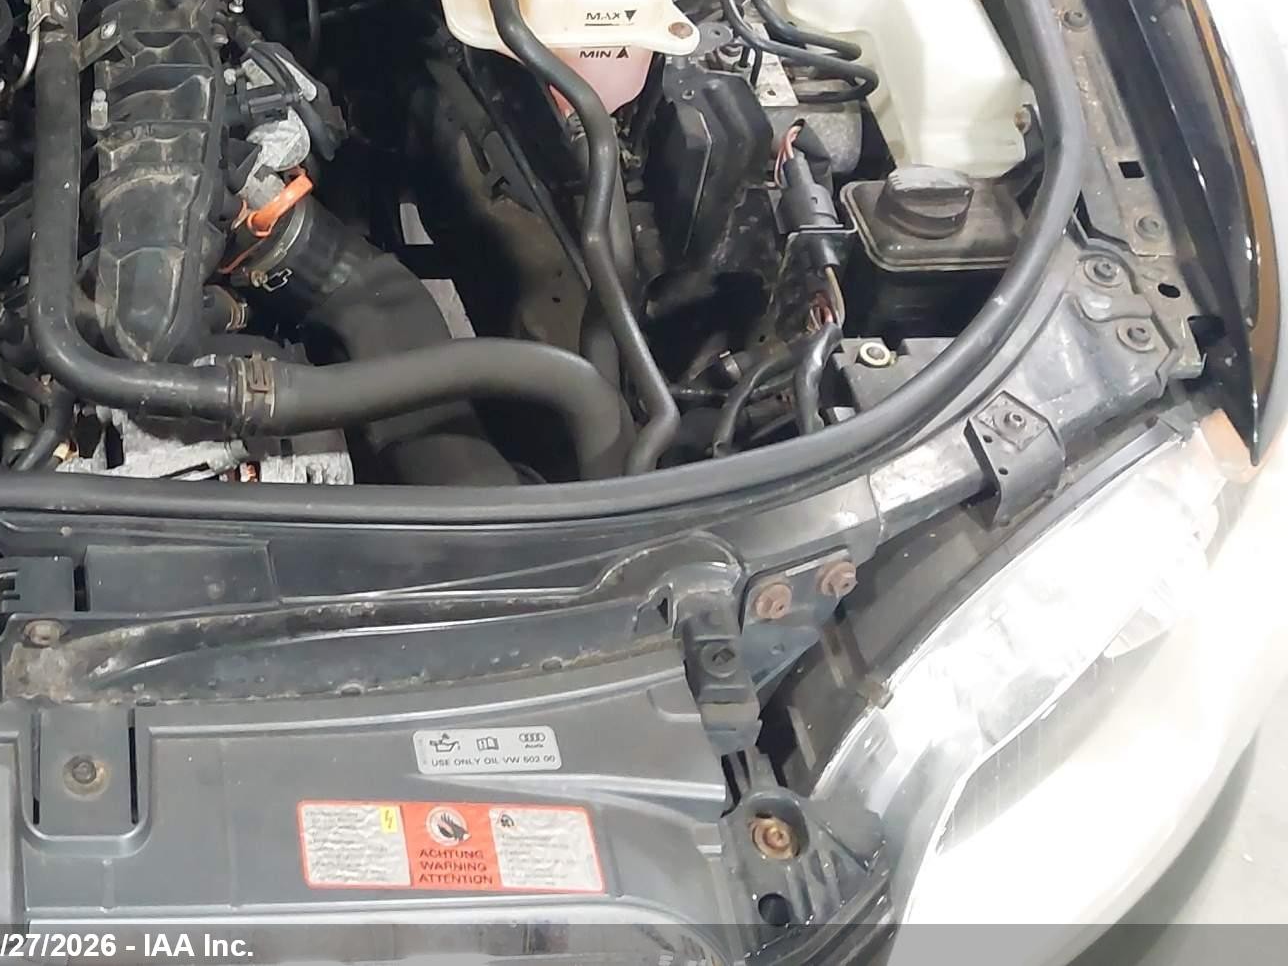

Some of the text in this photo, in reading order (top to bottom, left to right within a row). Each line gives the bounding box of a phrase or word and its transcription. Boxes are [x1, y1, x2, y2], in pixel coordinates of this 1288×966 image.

[586, 12, 620, 20] MAX
[579, 50, 612, 58] MIN
[432, 758, 449, 767] USE
[454, 757, 480, 766] ONLY
[484, 756, 498, 765] OIL
[503, 755, 519, 764] VW
[419, 849, 484, 859] ACHTUNG
[420, 861, 487, 872] WARNING
[419, 873, 493, 884] ATTENTION
